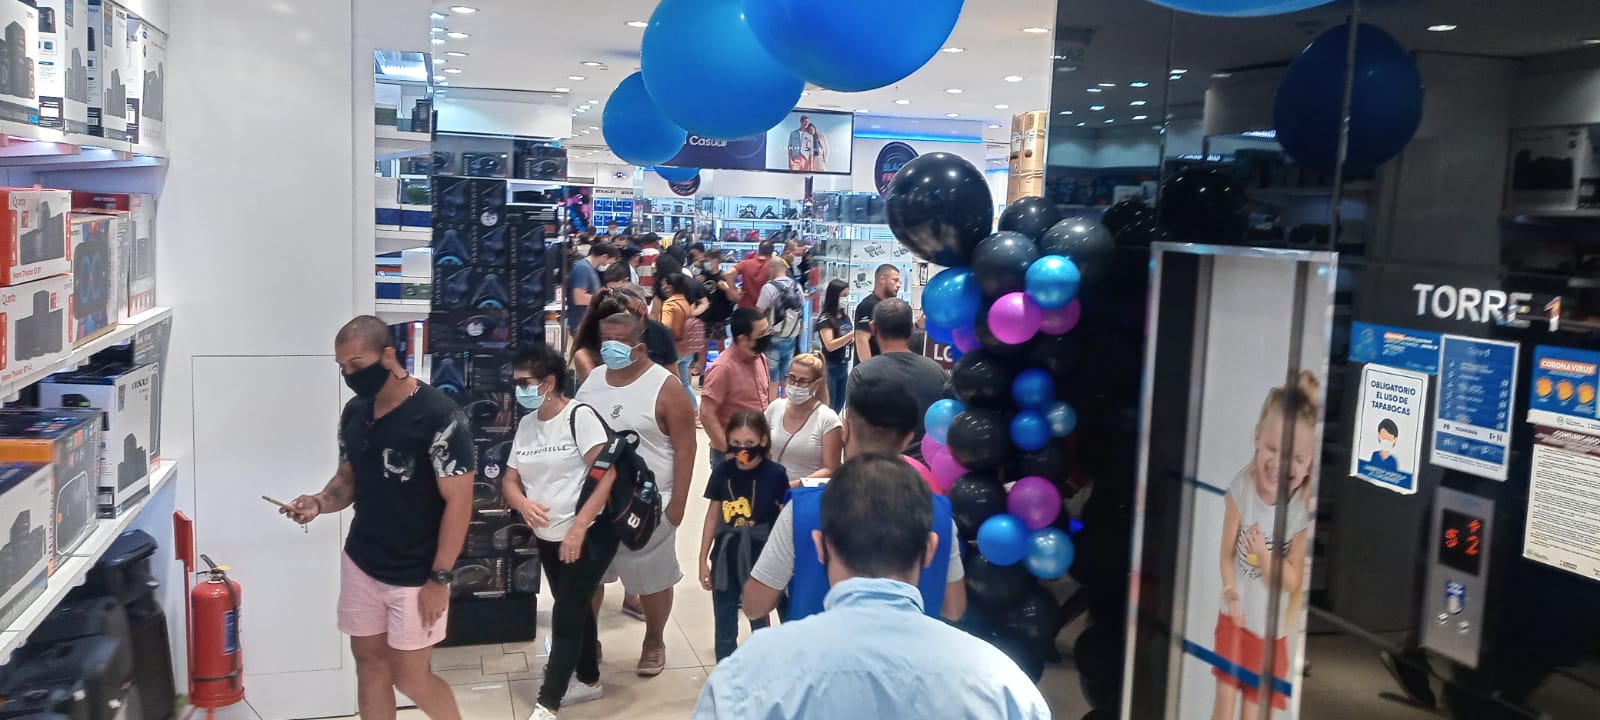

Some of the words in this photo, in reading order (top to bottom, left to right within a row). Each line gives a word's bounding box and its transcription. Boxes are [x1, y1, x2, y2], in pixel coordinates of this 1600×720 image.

[1412, 283, 1534, 329] TORRE
[1543, 295, 1562, 333] 1
[1541, 360, 1594, 373] CORONAVIRUS
[1370, 380, 1416, 396] OBLIGATORIO
[1376, 391, 1383, 400] EL
[1384, 393, 1398, 402] USO
[1398, 395, 1409, 405] DE
[1371, 400, 1411, 416] TAPABOCAS
